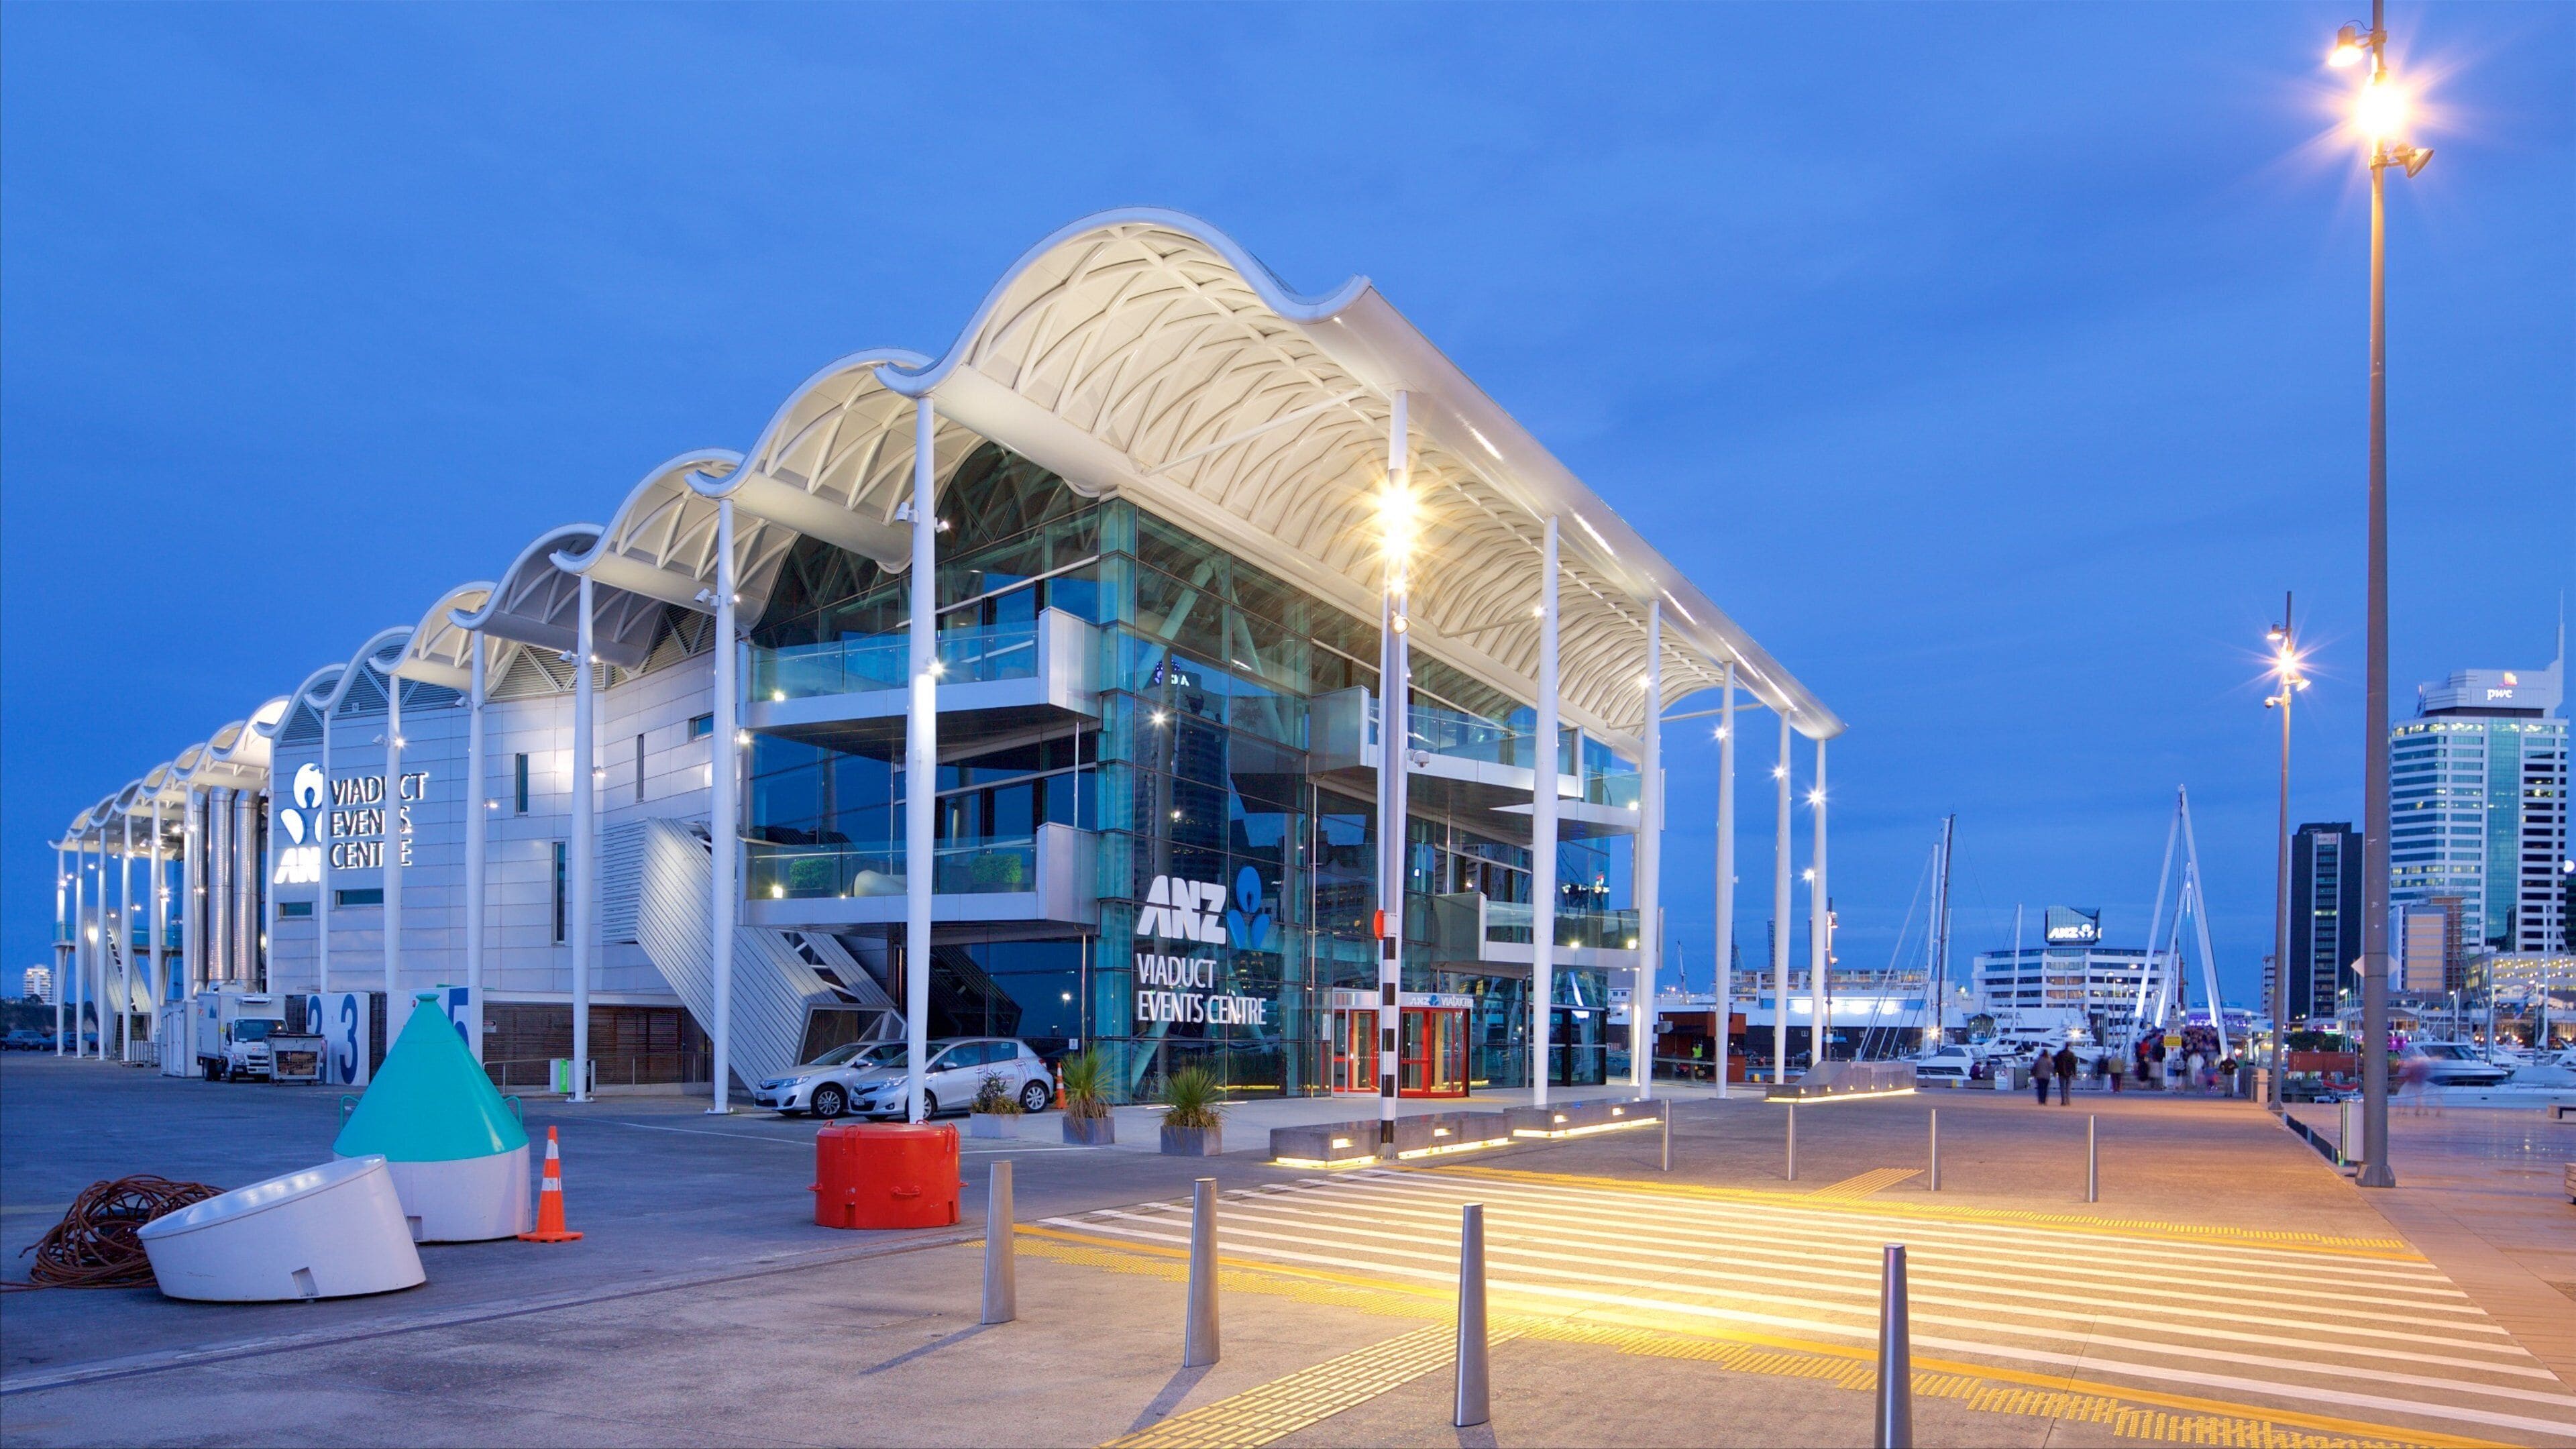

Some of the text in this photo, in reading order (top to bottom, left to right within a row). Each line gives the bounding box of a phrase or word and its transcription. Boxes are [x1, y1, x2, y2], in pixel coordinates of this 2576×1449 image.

[2487, 689, 2513, 700] pwc
[329, 806, 413, 838] EVENS
[274, 847, 321, 884] AN
[329, 839, 413, 869] CENTE
[1136, 875, 1227, 945] ANZ
[2049, 927, 2079, 938] ANZ
[1136, 953, 1217, 989] VIADUCT
[1138, 990, 1267, 1025] EVENTS CENTRE
[339, 994, 358, 1085] 3
